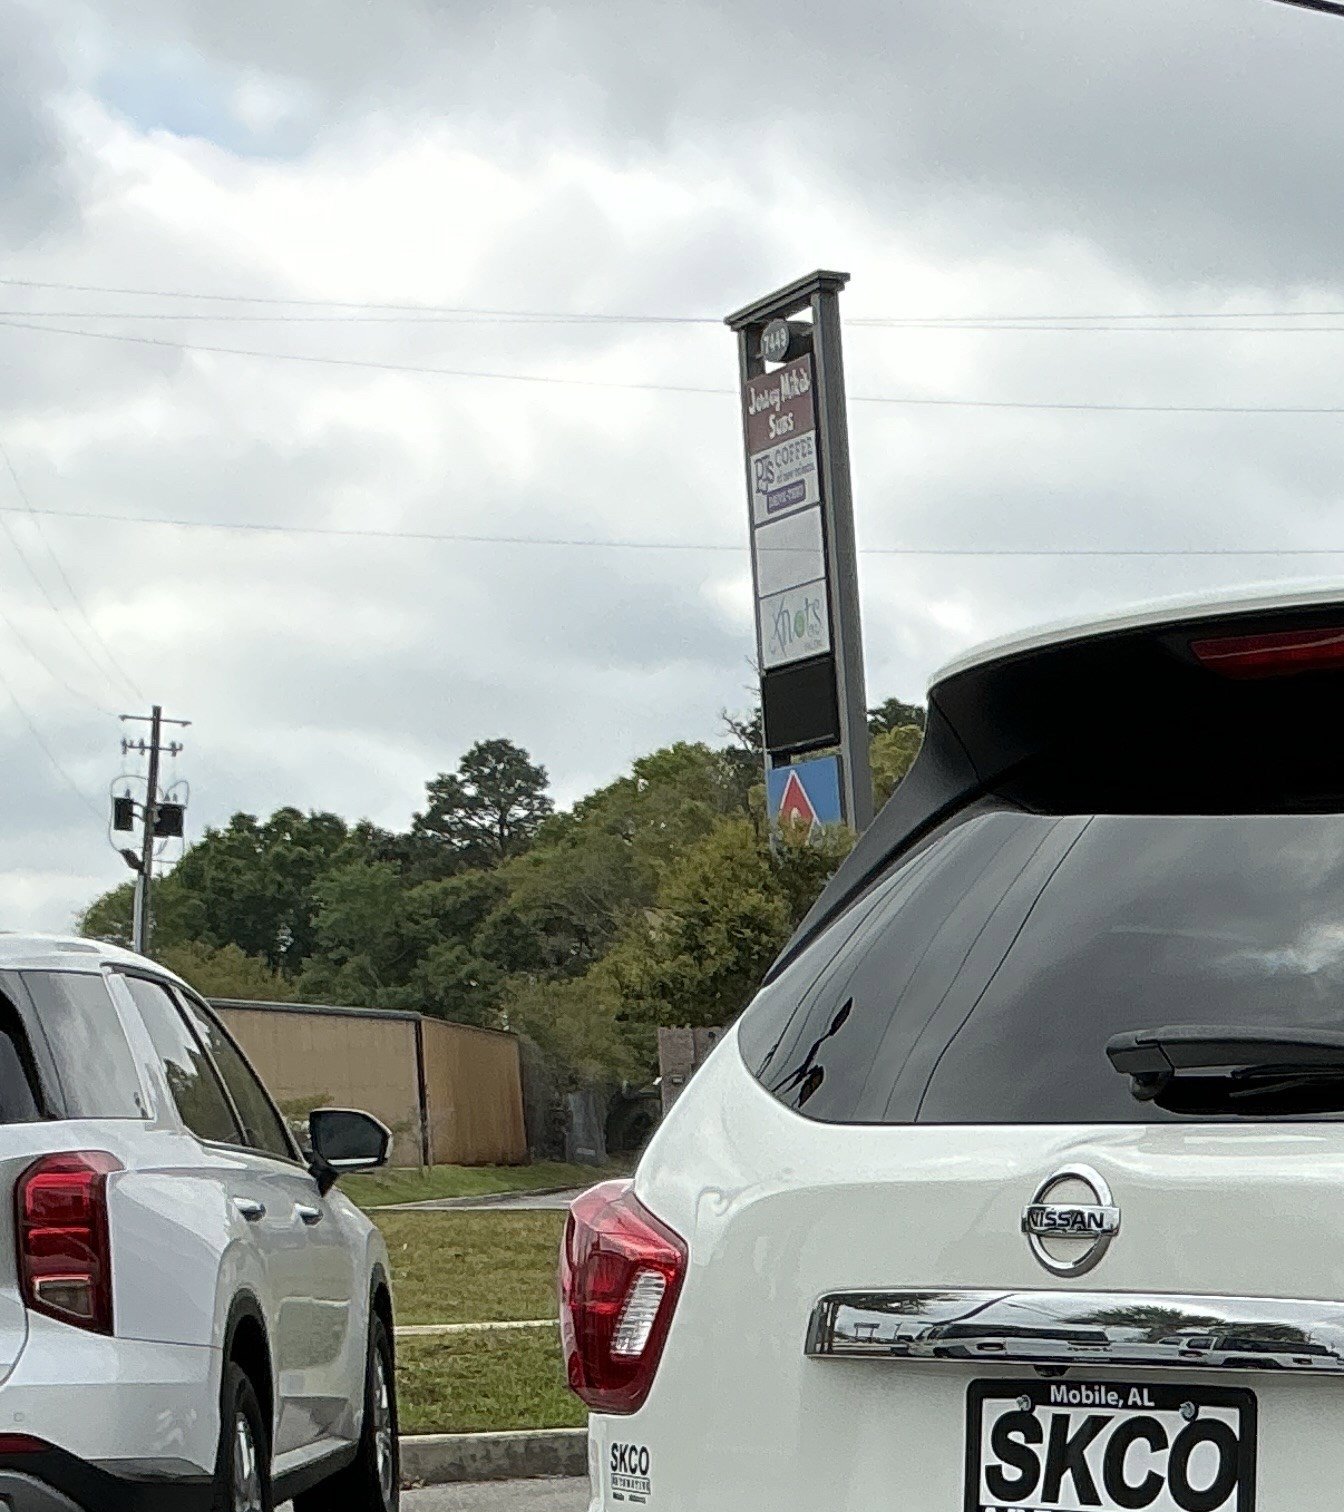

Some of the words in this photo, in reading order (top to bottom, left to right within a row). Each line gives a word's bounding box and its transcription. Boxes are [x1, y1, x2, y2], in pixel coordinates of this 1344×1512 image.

[1027, 1207, 1104, 1229] NISSAN
[1050, 1384, 1124, 1408] Mobile,
[1127, 1387, 1156, 1407] AL
[610, 1442, 650, 1476] SKCO
